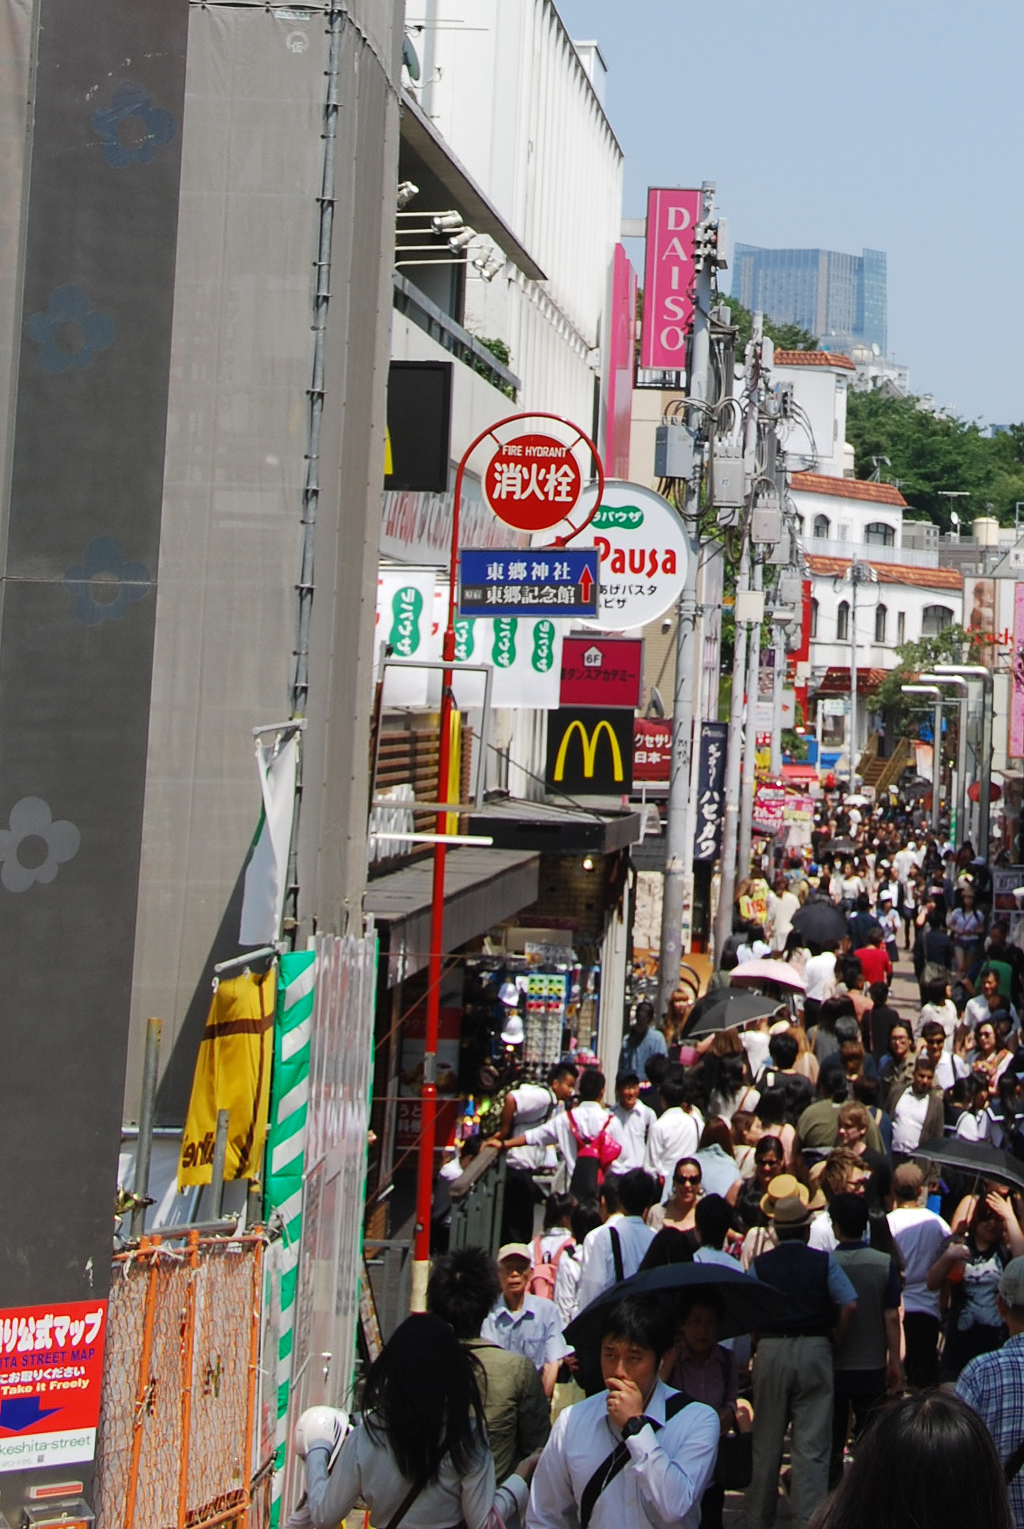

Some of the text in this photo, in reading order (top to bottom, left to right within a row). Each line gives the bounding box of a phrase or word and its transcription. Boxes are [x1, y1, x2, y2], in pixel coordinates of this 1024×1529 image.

[660, 206, 691, 351] DAISO
[502, 444, 568, 458] FIRE HYDRANT
[492, 462, 576, 503] 消火栓
[486, 561, 572, 581] 東郷神社
[485, 585, 576, 605] 東郷記念館
[586, 654, 600, 664] 6F
[0, 1308, 103, 1354] り公式マップ
[22, 1351, 67, 1367] STREET
[70, 1348, 95, 1361] MAP
[1, 1384, 33, 1395] Take
[49, 1378, 90, 1390] Freely
